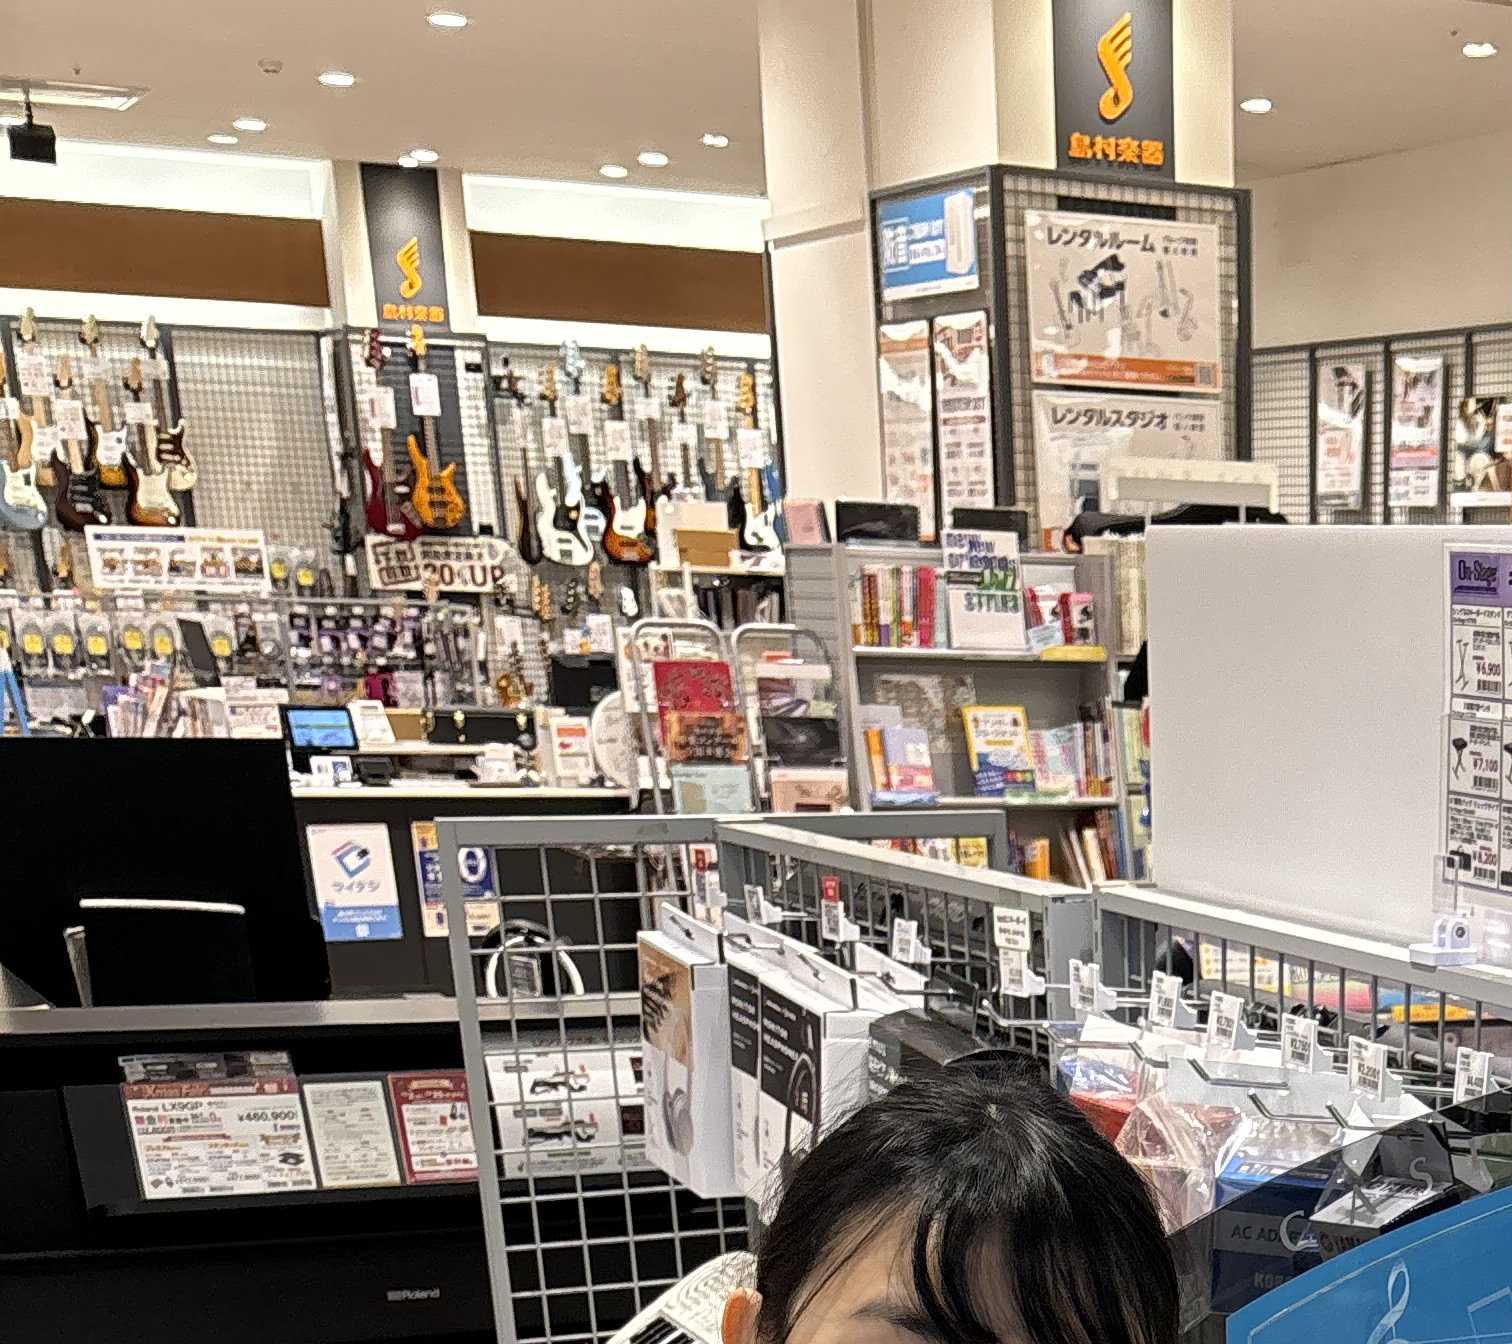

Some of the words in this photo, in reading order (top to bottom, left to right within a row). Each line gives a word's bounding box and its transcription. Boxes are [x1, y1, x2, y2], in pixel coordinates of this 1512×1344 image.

[1069, 131, 1165, 166] 島村楽器
[1047, 226, 1156, 254] レンタルルーム
[1051, 406, 1168, 430] レンタルスタジオ
